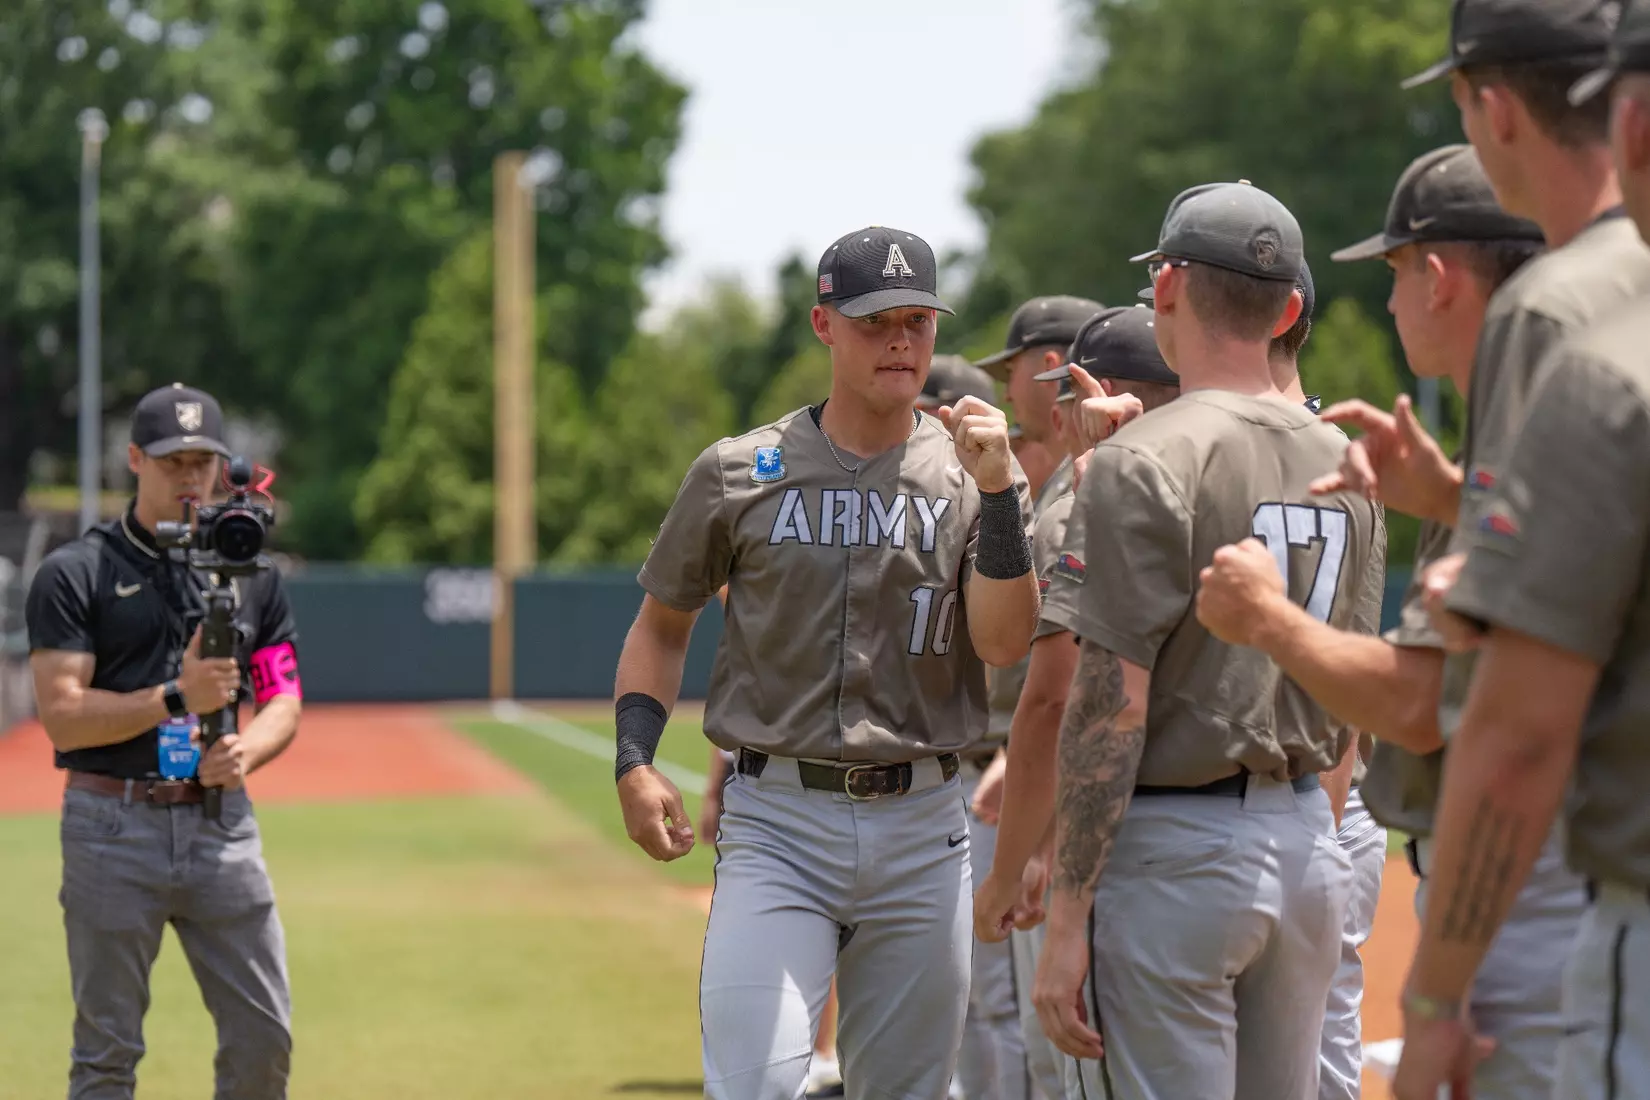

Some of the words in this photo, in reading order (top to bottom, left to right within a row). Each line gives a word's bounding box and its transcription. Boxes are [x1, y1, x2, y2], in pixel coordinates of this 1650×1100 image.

[883, 244, 912, 277] A
[768, 488, 951, 553] ARMY
[1252, 502, 1348, 624] 17
[908, 586, 958, 656] 10
